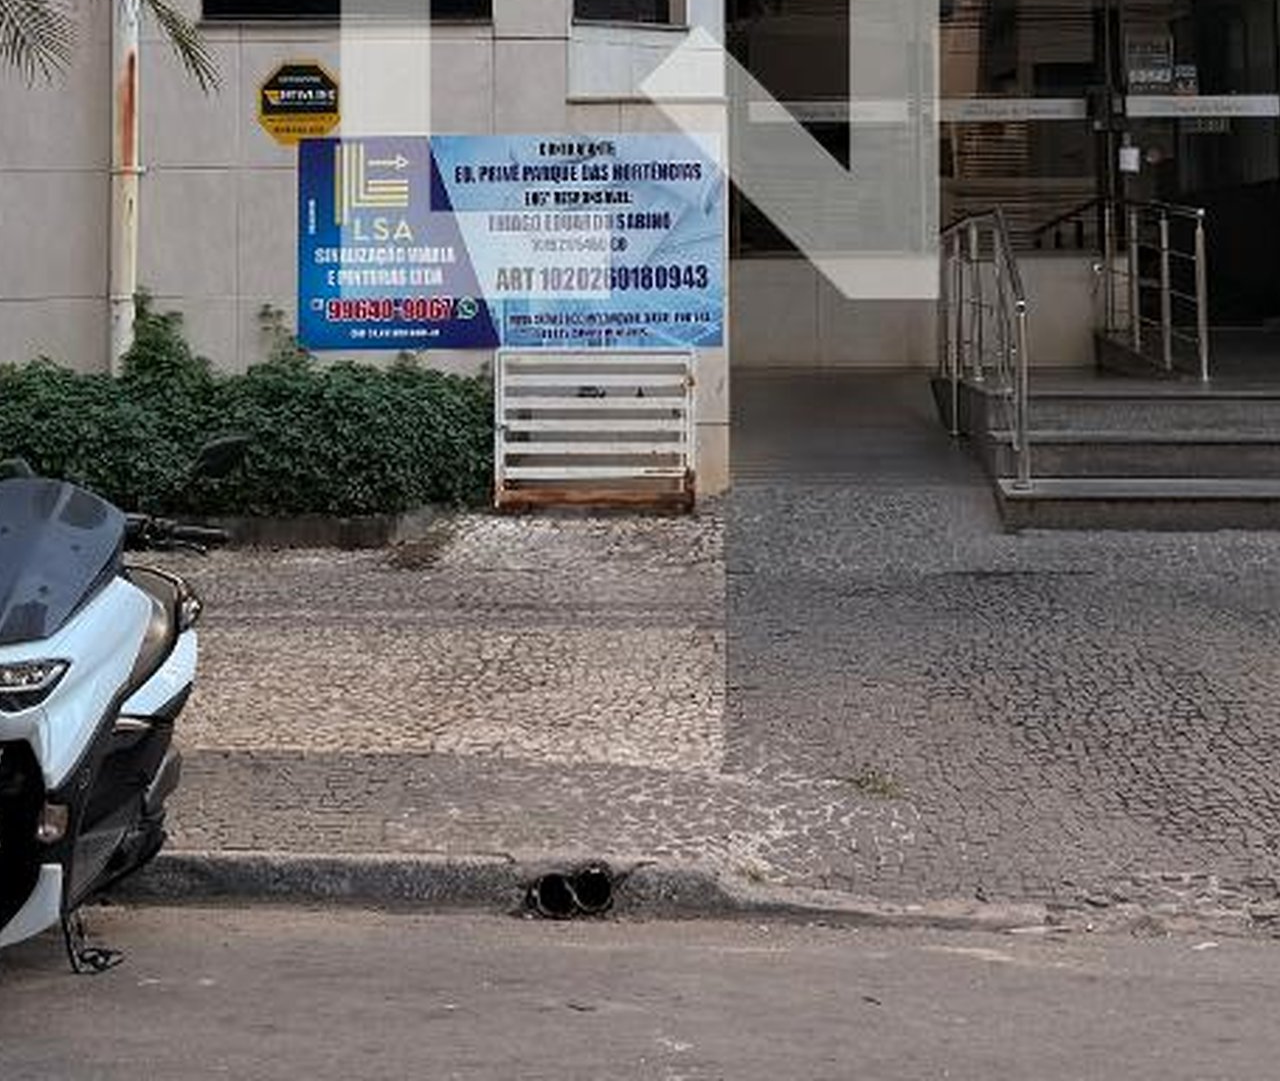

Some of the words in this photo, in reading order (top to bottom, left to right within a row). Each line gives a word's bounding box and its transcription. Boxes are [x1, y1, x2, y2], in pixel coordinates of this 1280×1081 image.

[522, 165, 579, 184] PARQUE
[353, 216, 414, 241] LSA
[496, 268, 536, 292] ART
